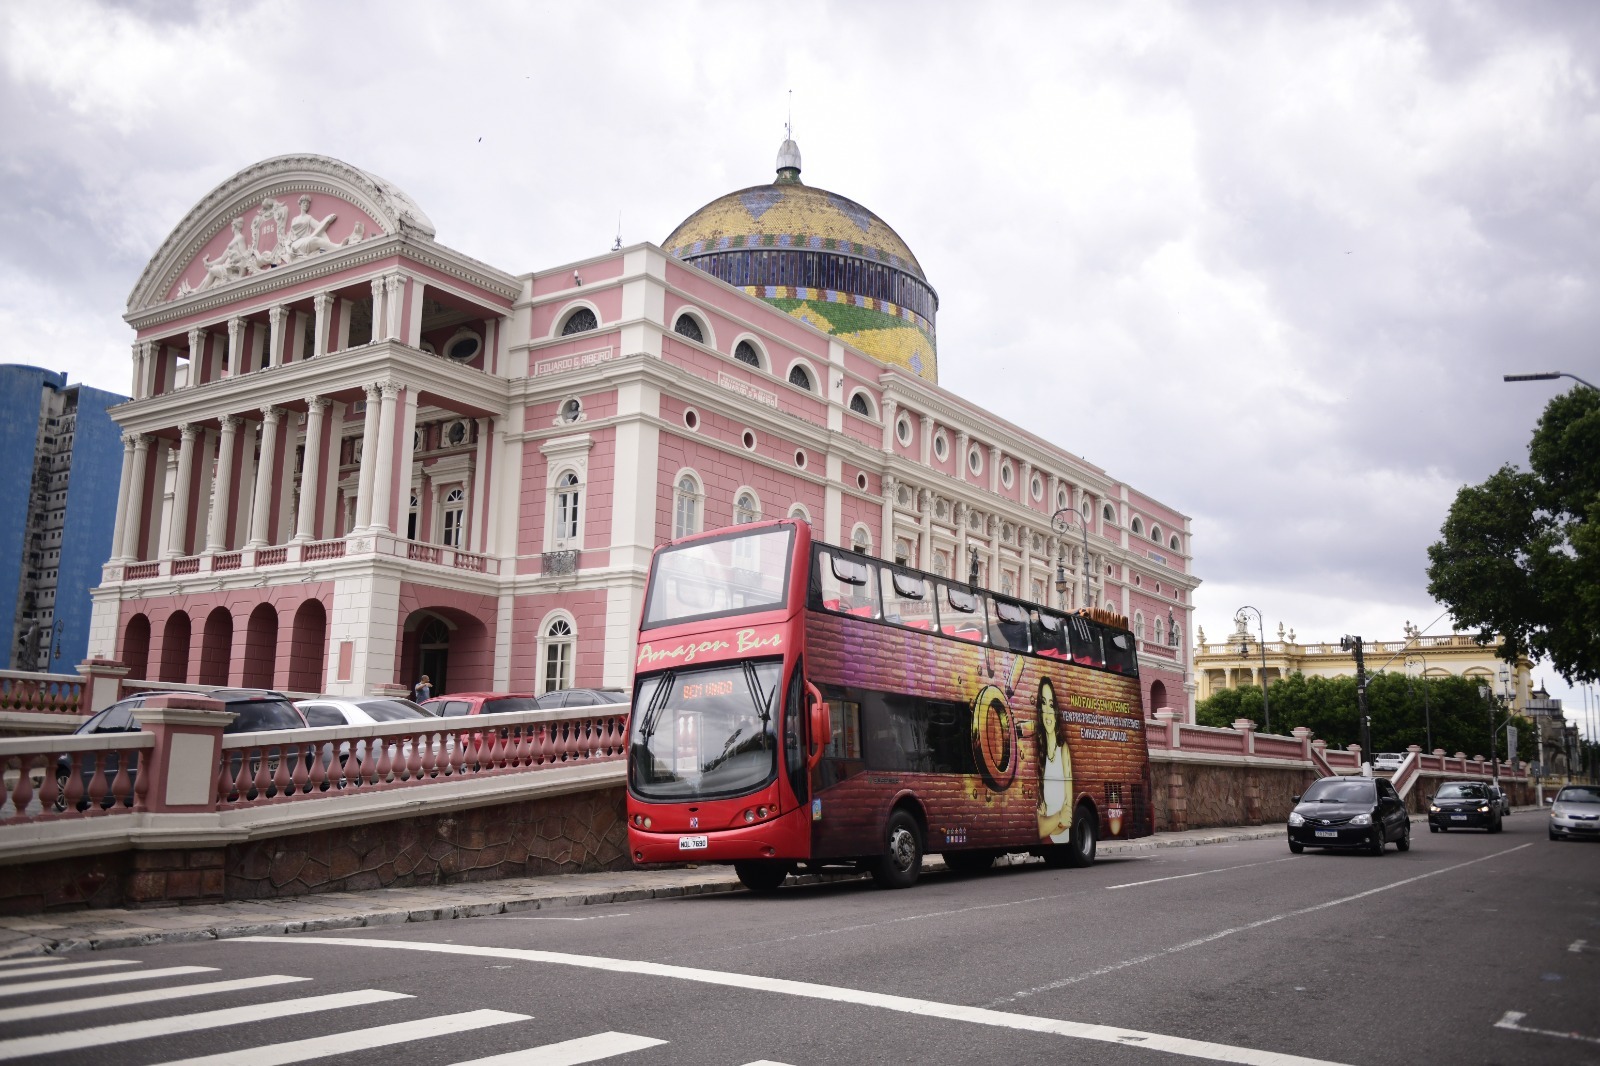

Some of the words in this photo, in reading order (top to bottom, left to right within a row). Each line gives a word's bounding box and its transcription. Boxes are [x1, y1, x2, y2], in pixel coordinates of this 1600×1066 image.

[539, 358, 573, 374] EDUARDO
[581, 350, 610, 364] RIBEIRO
[637, 640, 730, 667] Amazon
[736, 628, 782, 653] Bus
[683, 683, 703, 699] BEM
[705, 680, 733, 697] VINDO
[1097, 698, 1107, 711] SEM
[1107, 701, 1130, 713] INTERNET
[1084, 728, 1107, 740] WHATSAPP
